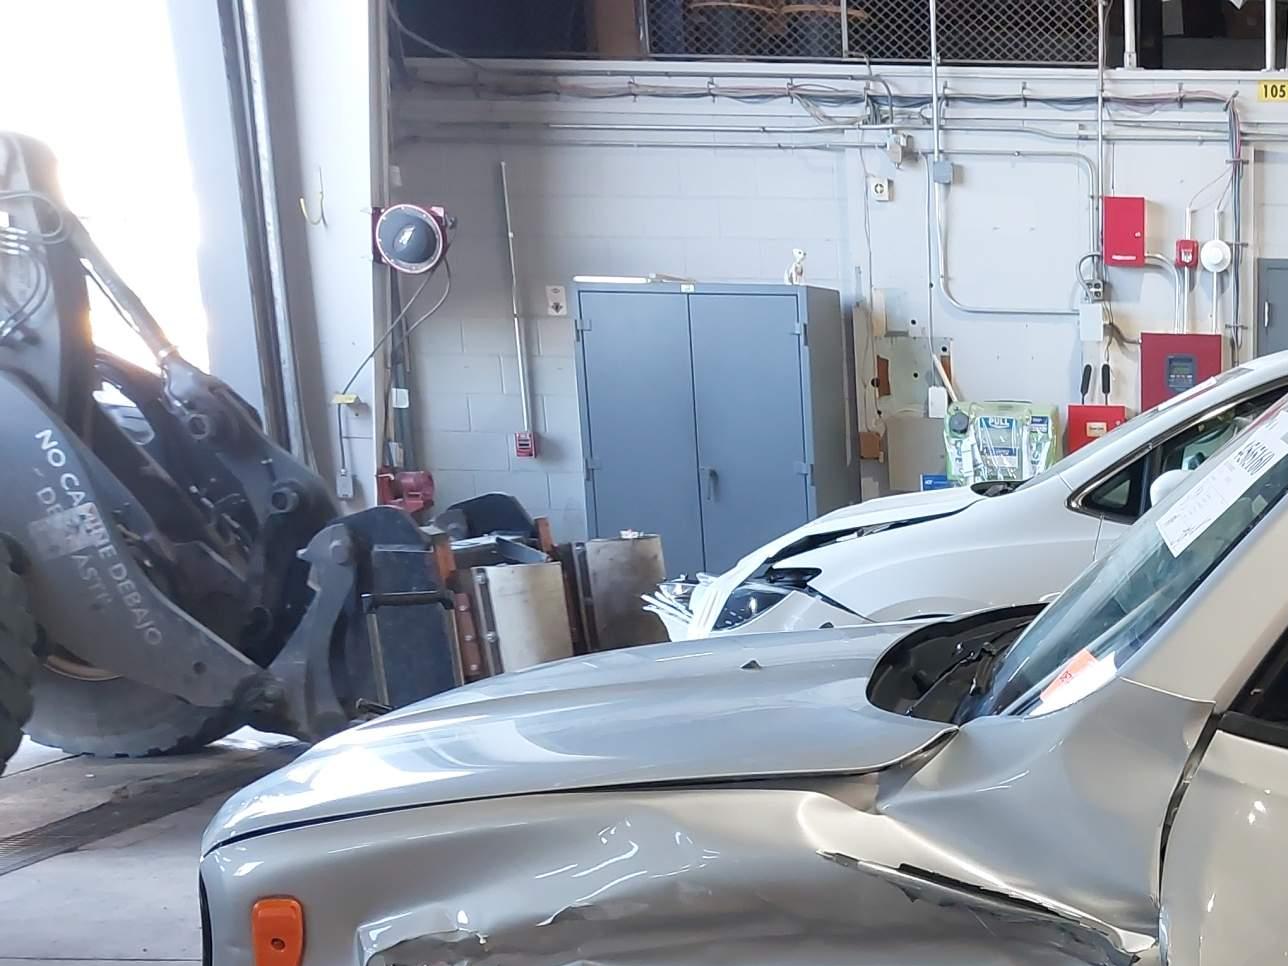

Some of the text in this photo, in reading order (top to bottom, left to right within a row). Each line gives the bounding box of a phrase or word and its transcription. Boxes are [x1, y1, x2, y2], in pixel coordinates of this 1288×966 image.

[1263, 84, 1286, 98] 105
[35, 429, 66, 467] NO
[109, 563, 163, 646] DEBAJO
